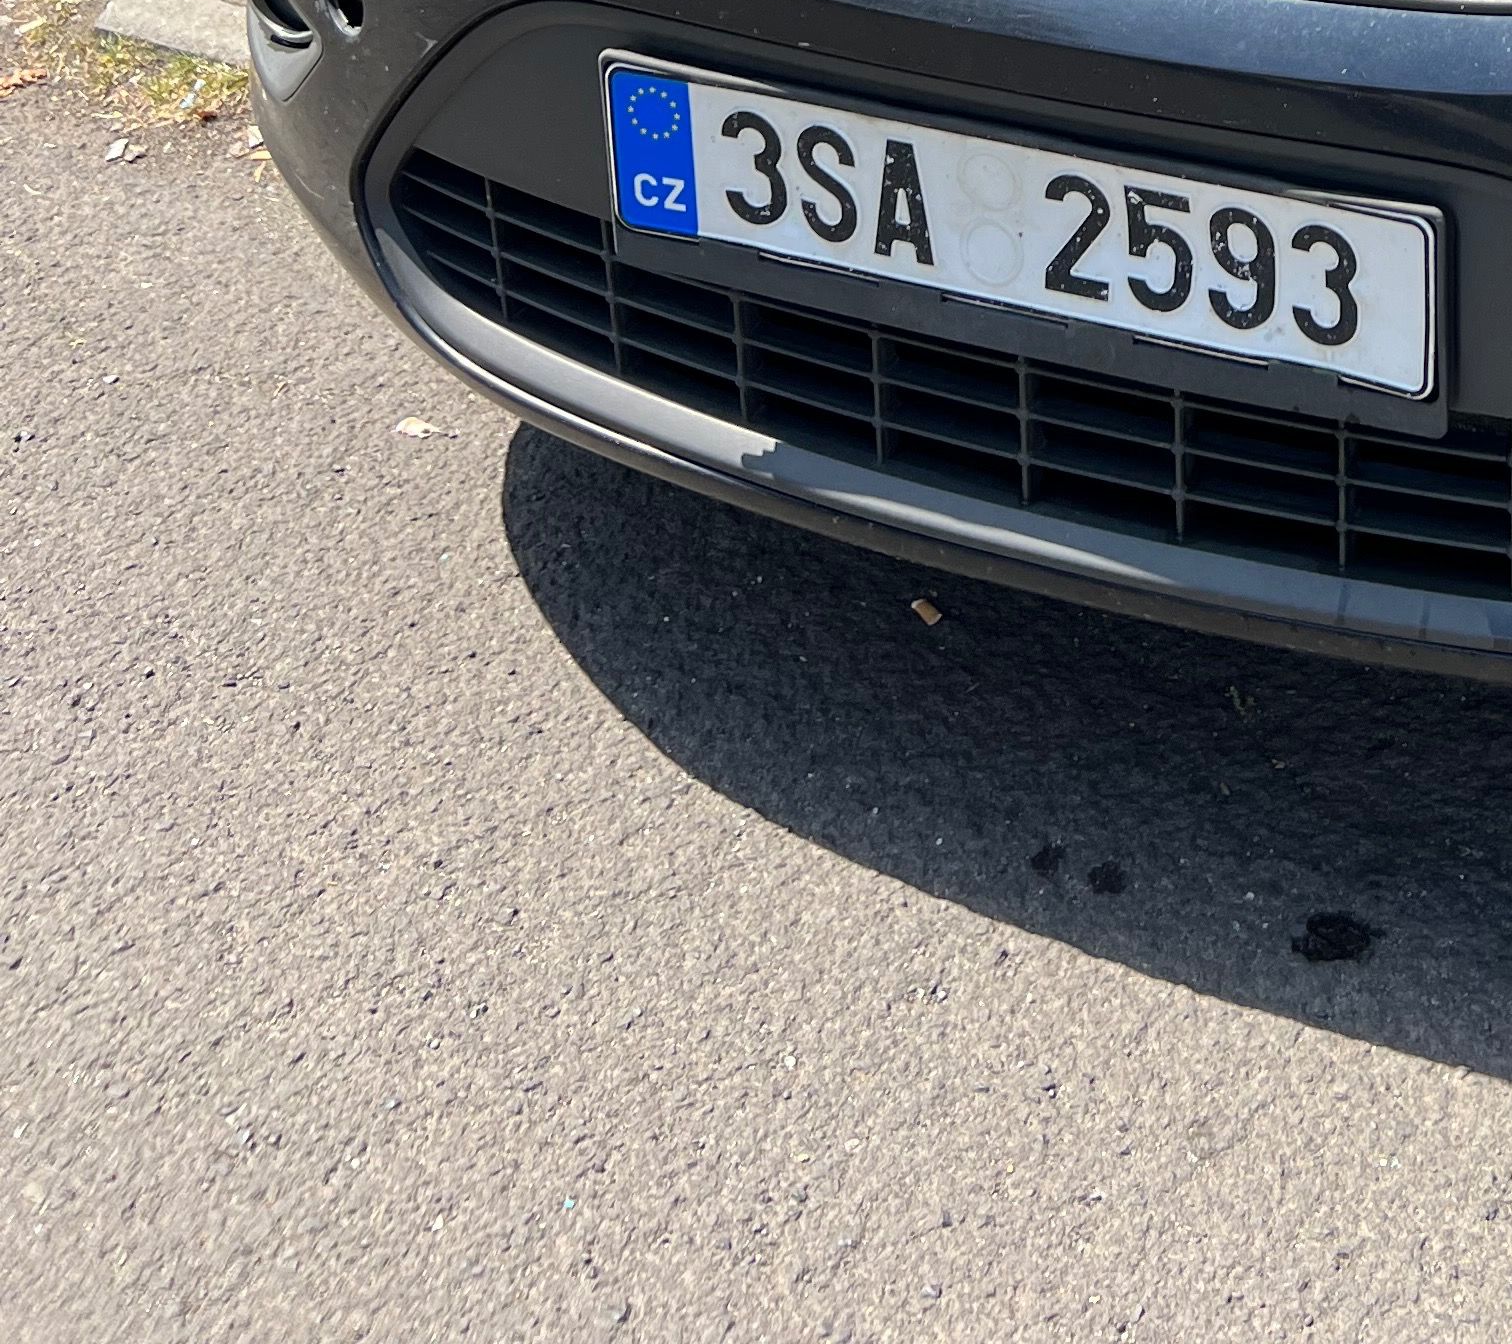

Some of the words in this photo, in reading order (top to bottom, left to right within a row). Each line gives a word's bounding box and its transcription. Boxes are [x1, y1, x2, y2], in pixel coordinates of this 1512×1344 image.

[633, 172, 687, 212] CZ
[720, 111, 935, 266] 3SA
[1043, 174, 1359, 346] 2593
